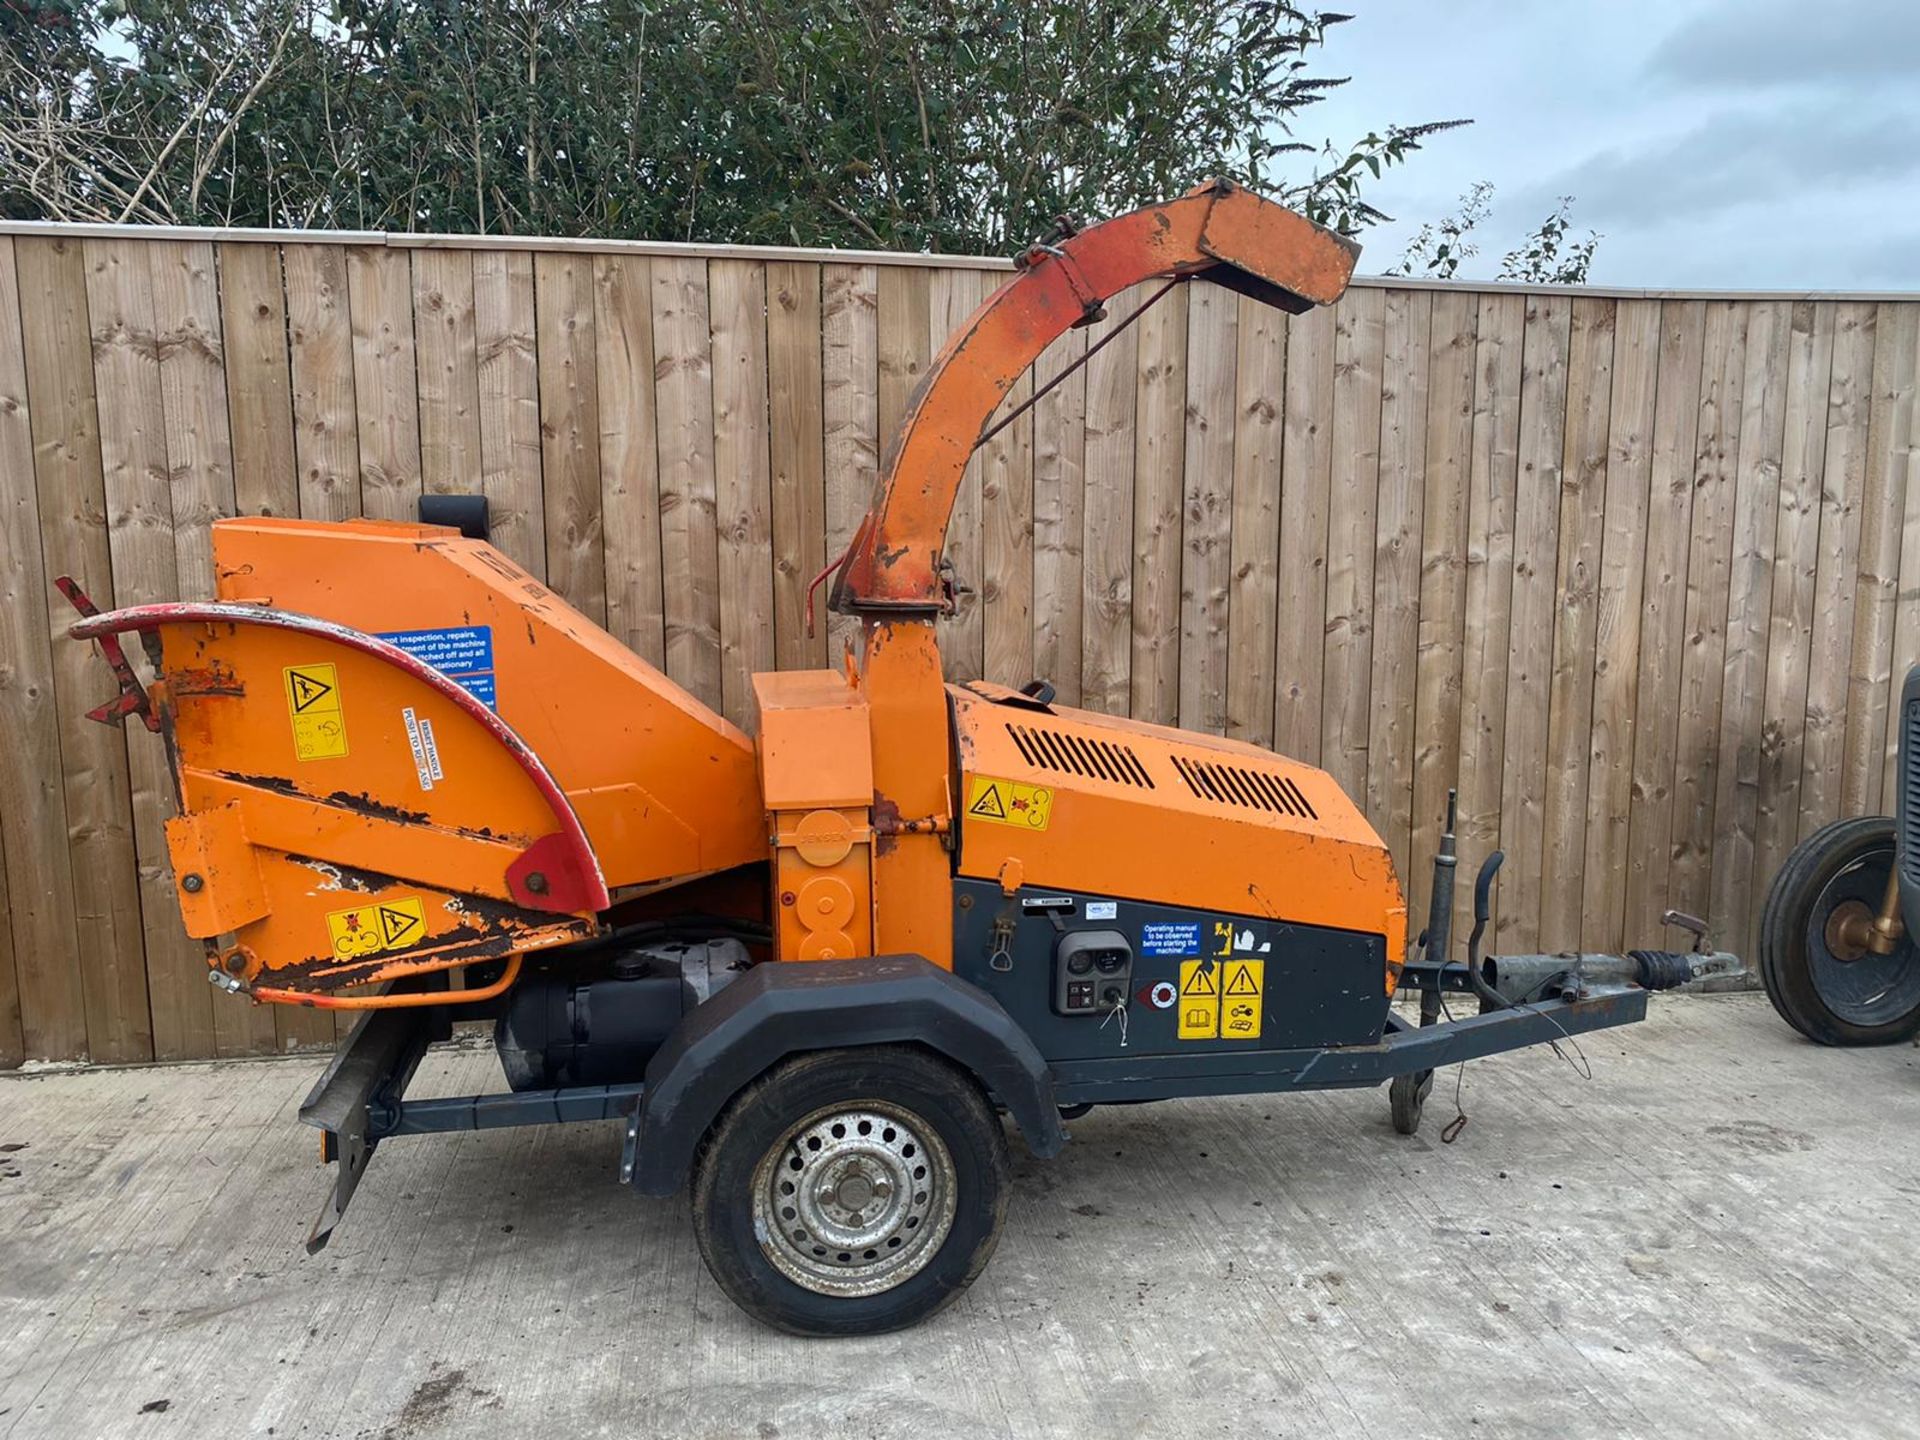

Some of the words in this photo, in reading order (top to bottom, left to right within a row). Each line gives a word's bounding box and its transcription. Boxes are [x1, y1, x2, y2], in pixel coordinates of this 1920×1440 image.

[400, 633, 446, 644] inspection,
[447, 630, 477, 641] repairs,
[427, 643, 436, 651] of
[438, 642, 451, 650] the
[453, 640, 486, 649] machine
[445, 650, 457, 659] off
[459, 650, 474, 658] and
[475, 649, 485, 657] all
[404, 709, 416, 733] PUSH
[410, 736, 420, 748] TO
[421, 721, 432, 746] RESET
[427, 747, 441, 777] HANDLE
[1144, 924, 1174, 933] Operating
[1163, 940, 1187, 948] starting
